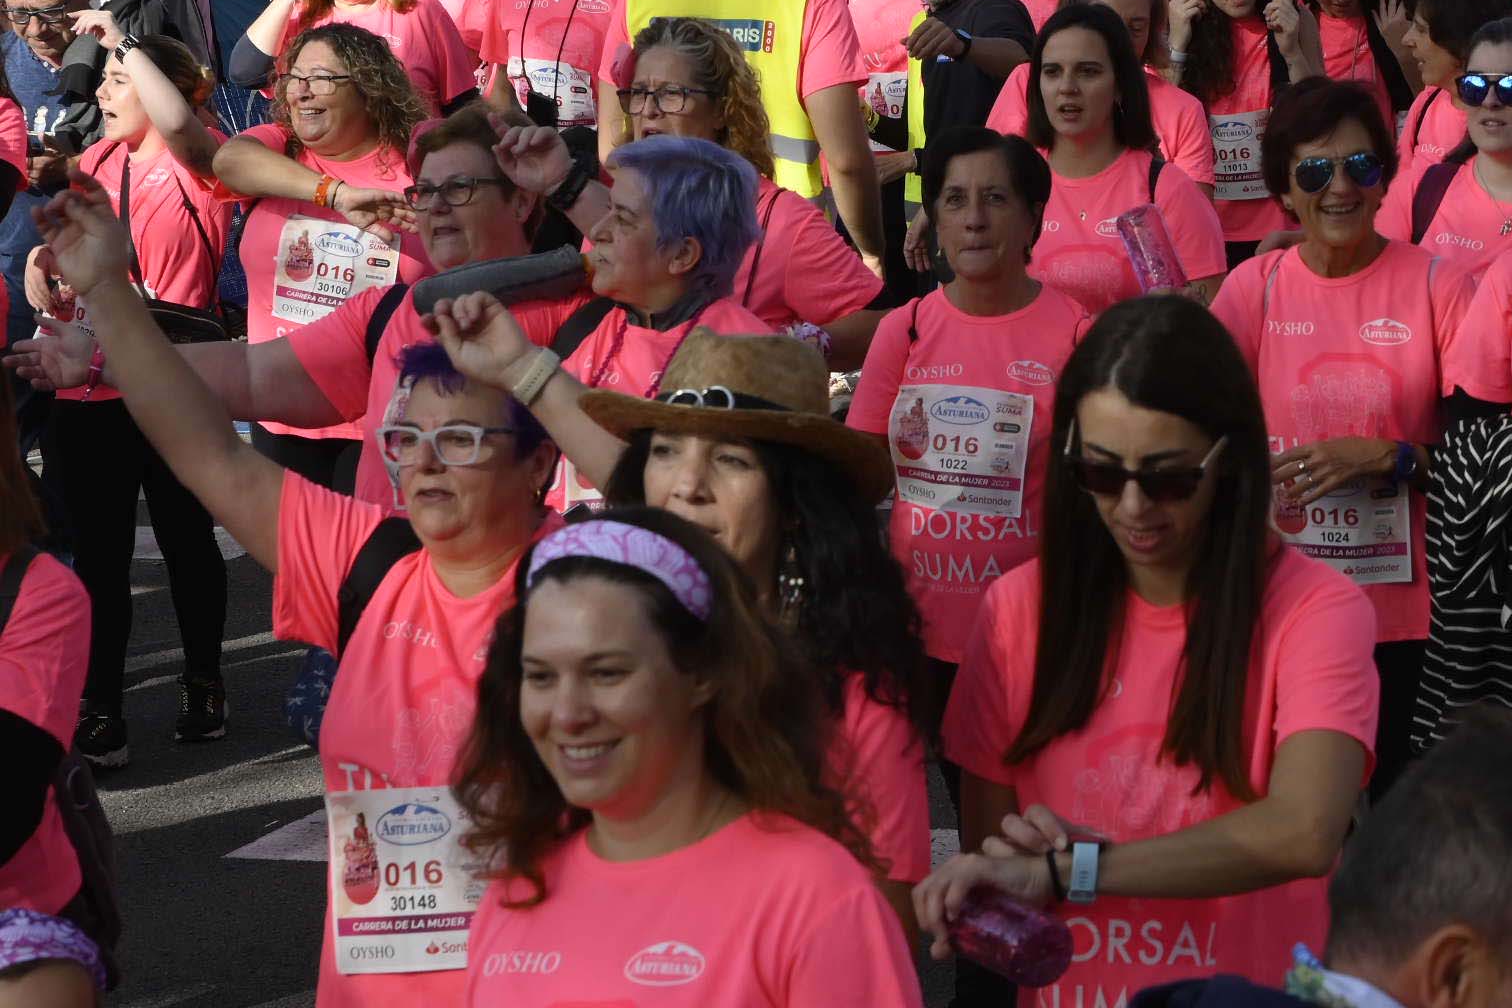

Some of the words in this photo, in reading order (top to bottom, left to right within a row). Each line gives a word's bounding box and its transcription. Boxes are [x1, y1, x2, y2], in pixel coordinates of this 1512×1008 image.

[515, 0, 549, 10] OYHO
[1218, 147, 1250, 160] 016
[1224, 163, 1248, 172] 11013
[319, 238, 361, 256] ASTURIANA
[316, 262, 355, 283] 016
[316, 282, 348, 296] 30106
[281, 303, 315, 317] OYSHO
[907, 364, 964, 381] OYSHO
[932, 405, 987, 421] ASTURIANA
[995, 405, 1023, 417] SUMA
[933, 434, 979, 455] 016
[939, 458, 969, 471] 1022
[937, 474, 948, 482] DE
[949, 475, 960, 483] LA
[961, 476, 989, 486] MUJER
[908, 485, 936, 500] OYSHO
[968, 494, 1013, 507] Santander
[911, 507, 1038, 541] DORSAL
[1311, 507, 1360, 526] 016
[1320, 532, 1350, 543] 1024
[1333, 548, 1343, 556] LA
[1345, 547, 1374, 556] MUJER
[913, 550, 1003, 583] SUMA
[1355, 564, 1400, 575] Santander
[381, 821, 445, 836] ASTURIANA
[384, 860, 444, 886] 016
[391, 894, 438, 912] 30148
[352, 920, 394, 932] CARRERA
[394, 920, 410, 930] DE
[410, 919, 425, 929] LA
[427, 916, 466, 928] MUJER
[1066, 917, 1217, 966] ORSAL
[350, 945, 396, 960] OYSHO
[483, 951, 562, 977] OYSHO
